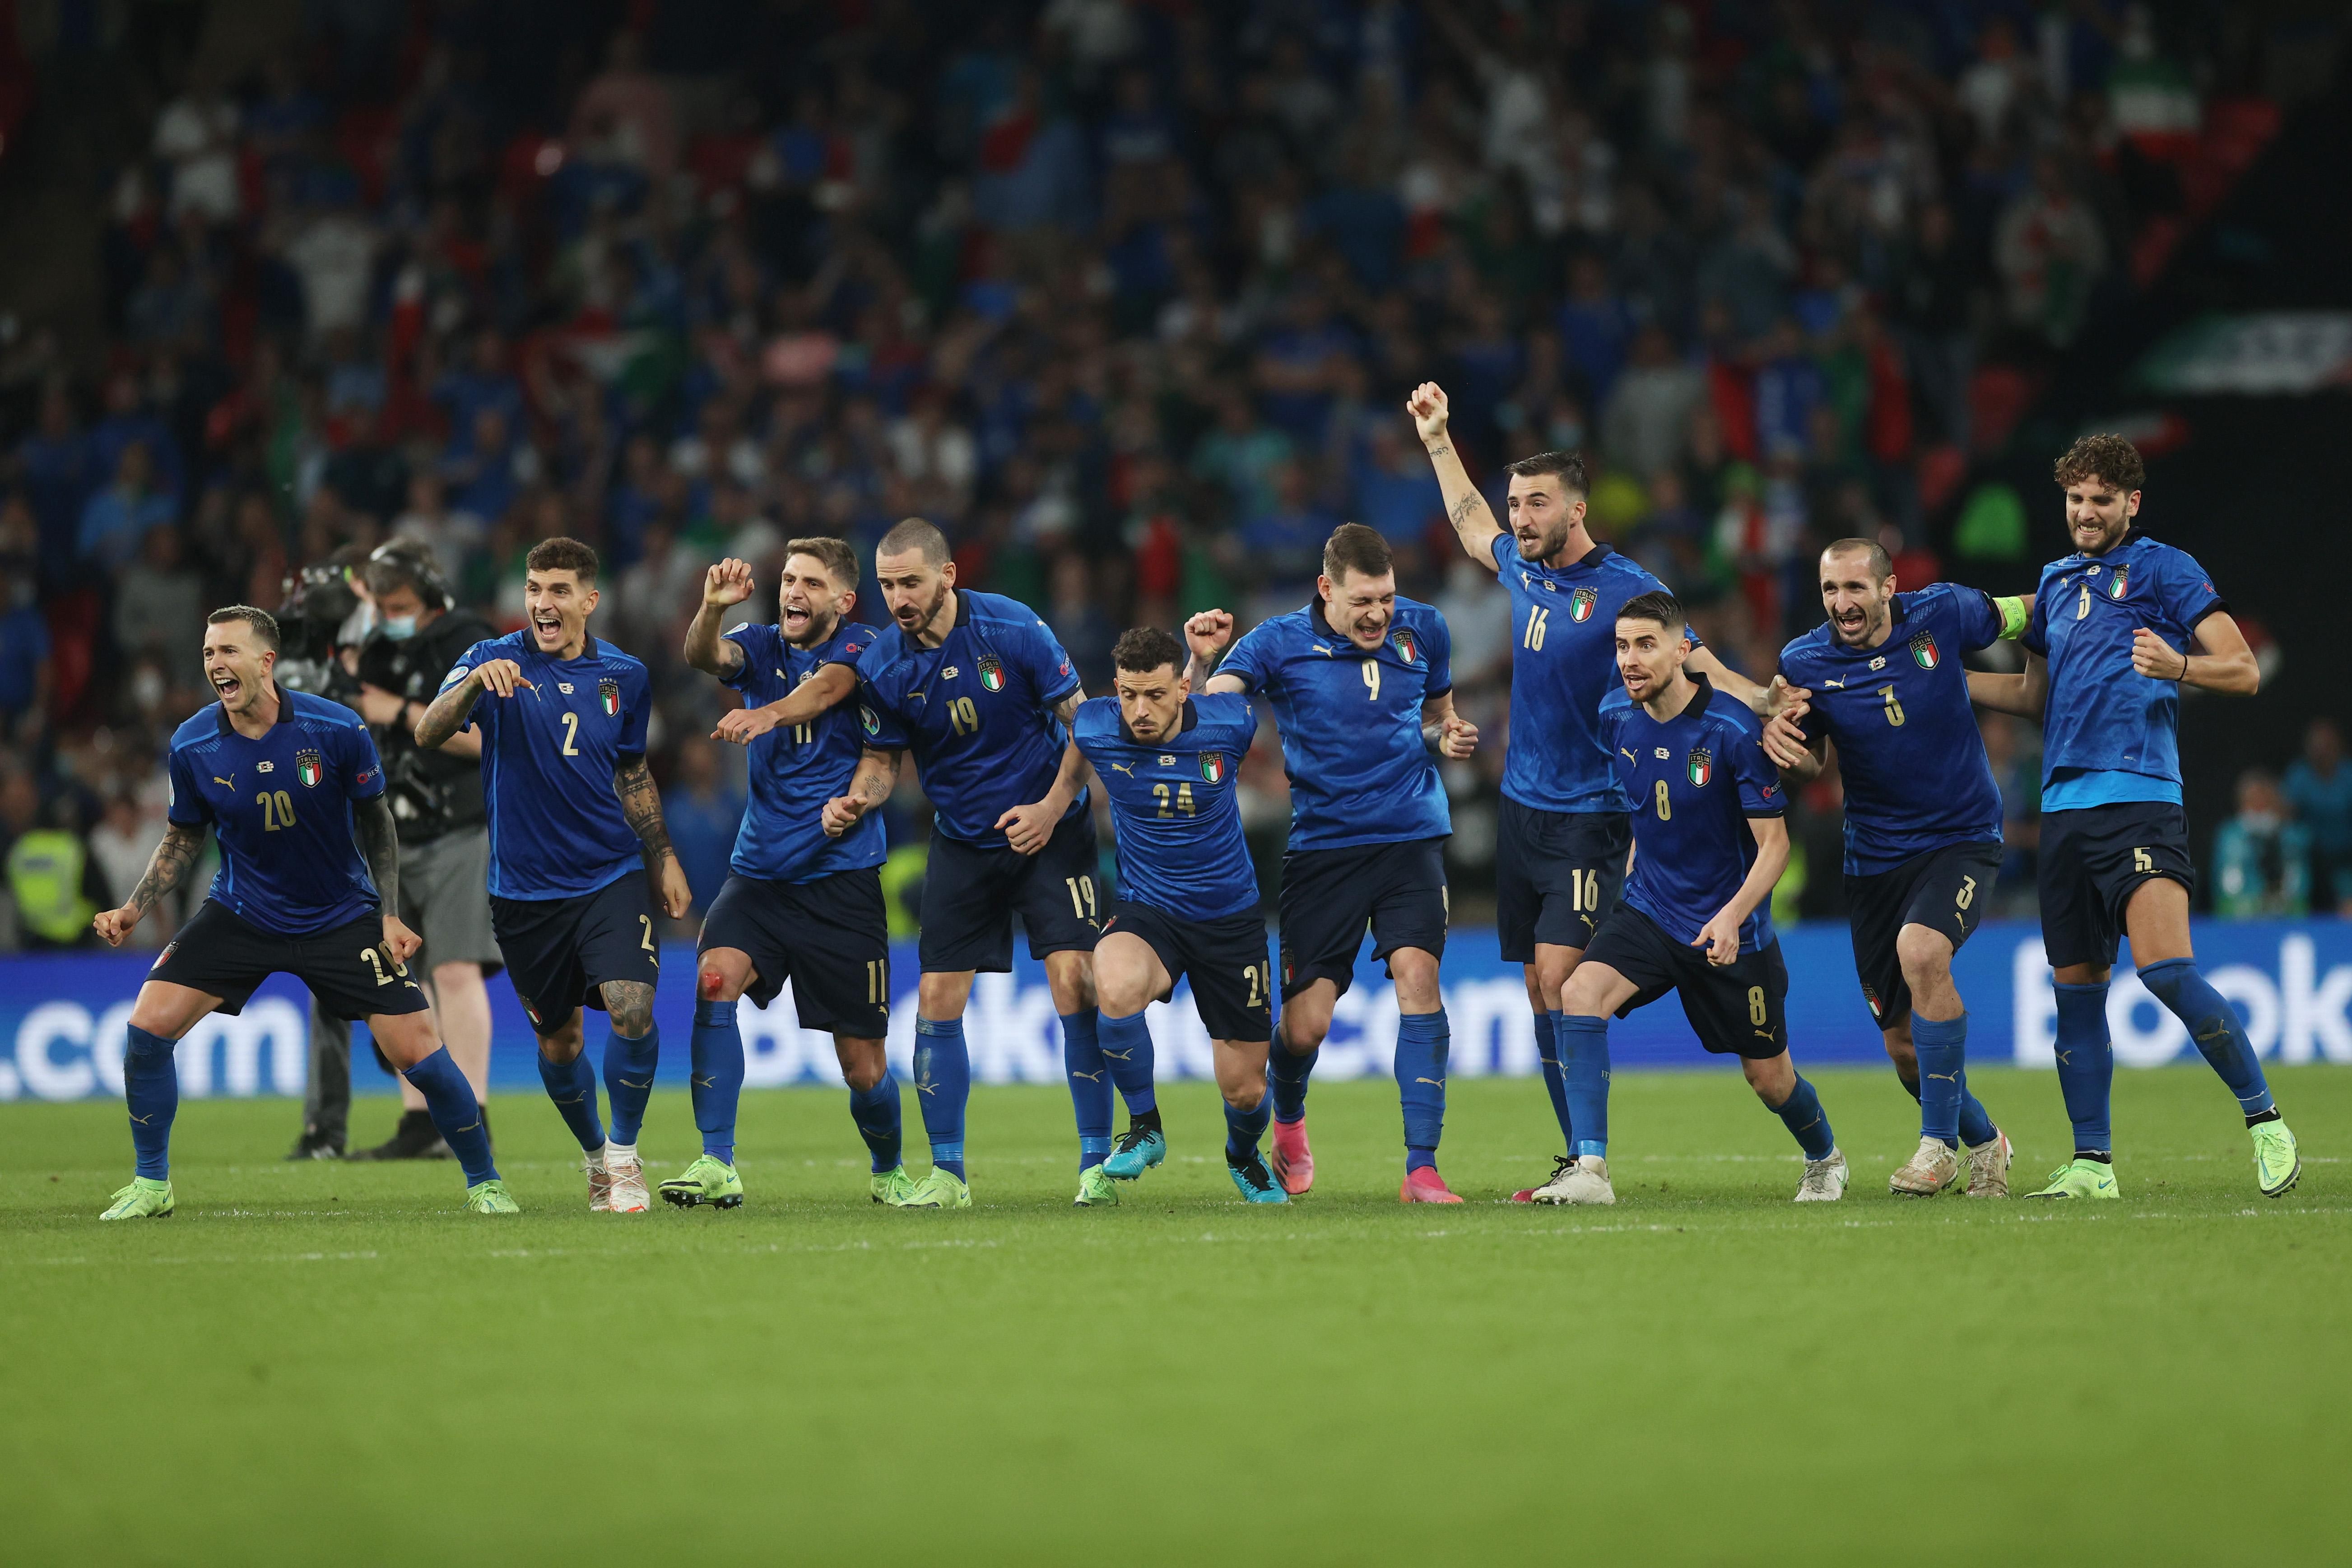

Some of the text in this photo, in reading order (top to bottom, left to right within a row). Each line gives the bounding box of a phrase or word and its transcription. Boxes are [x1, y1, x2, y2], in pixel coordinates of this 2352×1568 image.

[1576, 591, 1594, 600] ITALIA
[1524, 605, 1549, 651] 16
[1912, 637, 1931, 649] ITALIA
[980, 661, 999, 670] ITALIA
[1362, 658, 1380, 701] 9
[946, 697, 978, 736] 19
[1878, 684, 1906, 727] 3
[562, 712, 578, 756] 2
[1201, 753, 1220, 761] ITALIA
[256, 790, 296, 832] 20
[1153, 782, 1196, 818] 24
[1655, 780, 1671, 821] 8
[1066, 875, 1095, 918] 19
[1572, 869, 1598, 912] 16
[1956, 875, 1976, 910] 3
[639, 914, 655, 952] 2
[360, 940, 408, 986] 20
[867, 958, 885, 1003] 11
[1243, 960, 1270, 1007] 24
[1748, 986, 1766, 1026] 8
